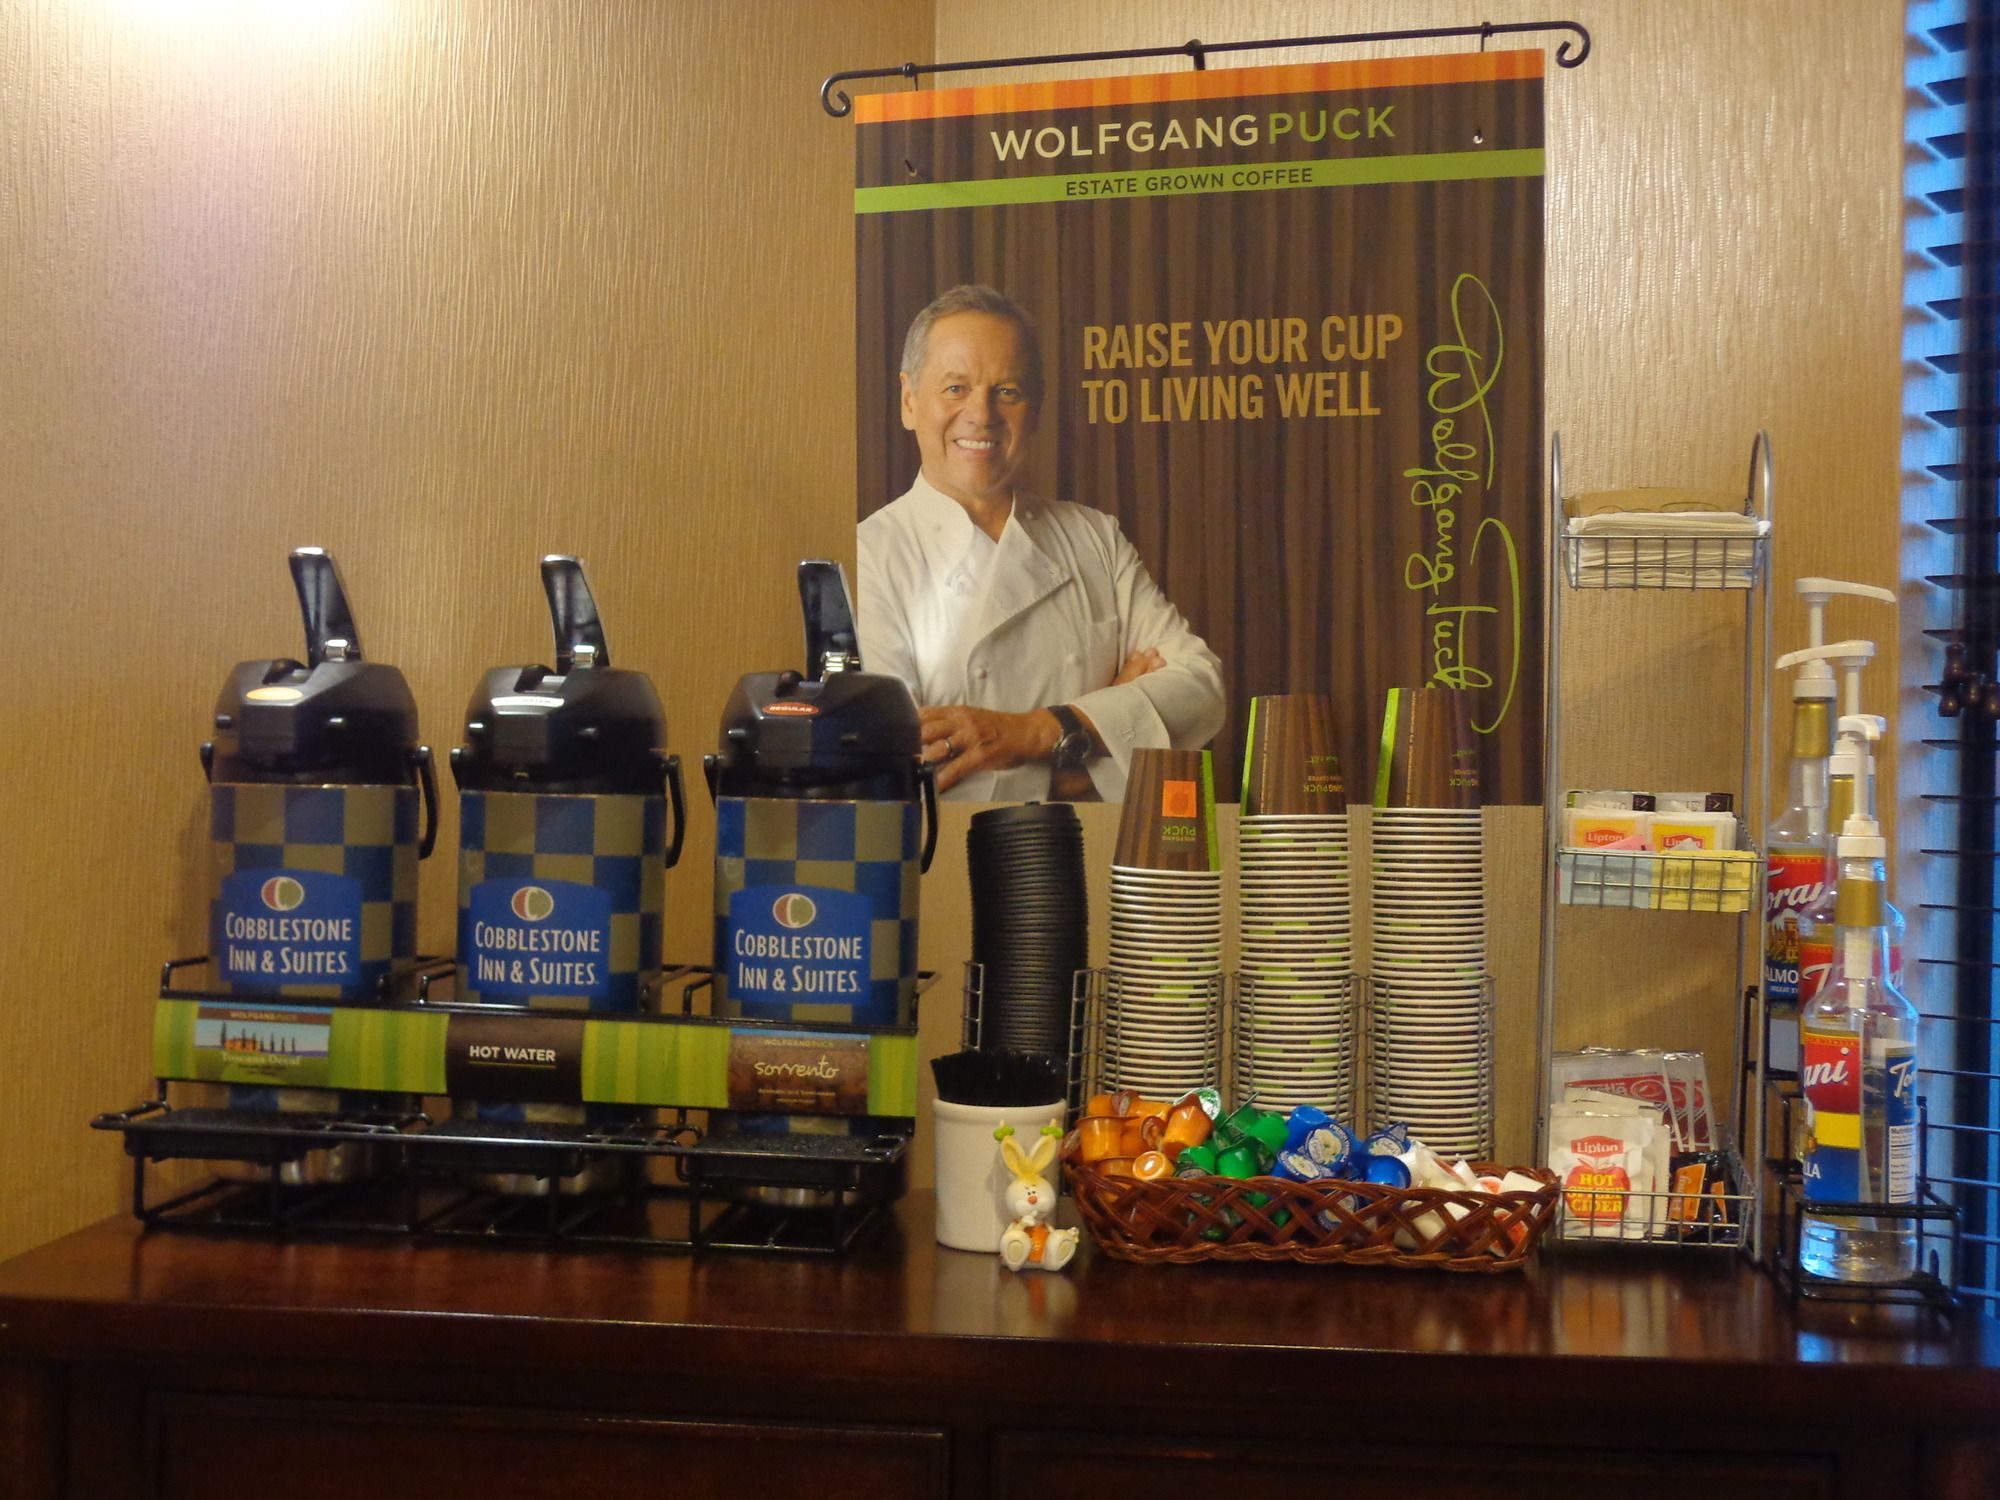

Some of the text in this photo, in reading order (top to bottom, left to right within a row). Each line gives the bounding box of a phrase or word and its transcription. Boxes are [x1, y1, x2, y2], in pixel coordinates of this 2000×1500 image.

[1066, 168, 1313, 197] ESTATE GROWN COFFEE
[1083, 314, 1402, 370] RAISE YOUR CUP
[1082, 371, 1380, 424] TO LIVING WELL
[1162, 825, 1197, 836] PUCK
[1587, 831, 1623, 844] Lipton
[225, 911, 353, 941] COBBLESTONE
[475, 920, 600, 952] COBBLESTONE
[228, 944, 347, 974] INN & SUITES
[735, 928, 863, 960] COBBLESTONE
[478, 953, 596, 985] INN & SUITES
[738, 962, 858, 993] INN & SUITES
[469, 1045, 557, 1062] HOT WATER
[1577, 1141, 1619, 1154] Lipton
[1580, 1174, 1616, 1186] HOT
[1571, 1199, 1622, 1212] CIDER
